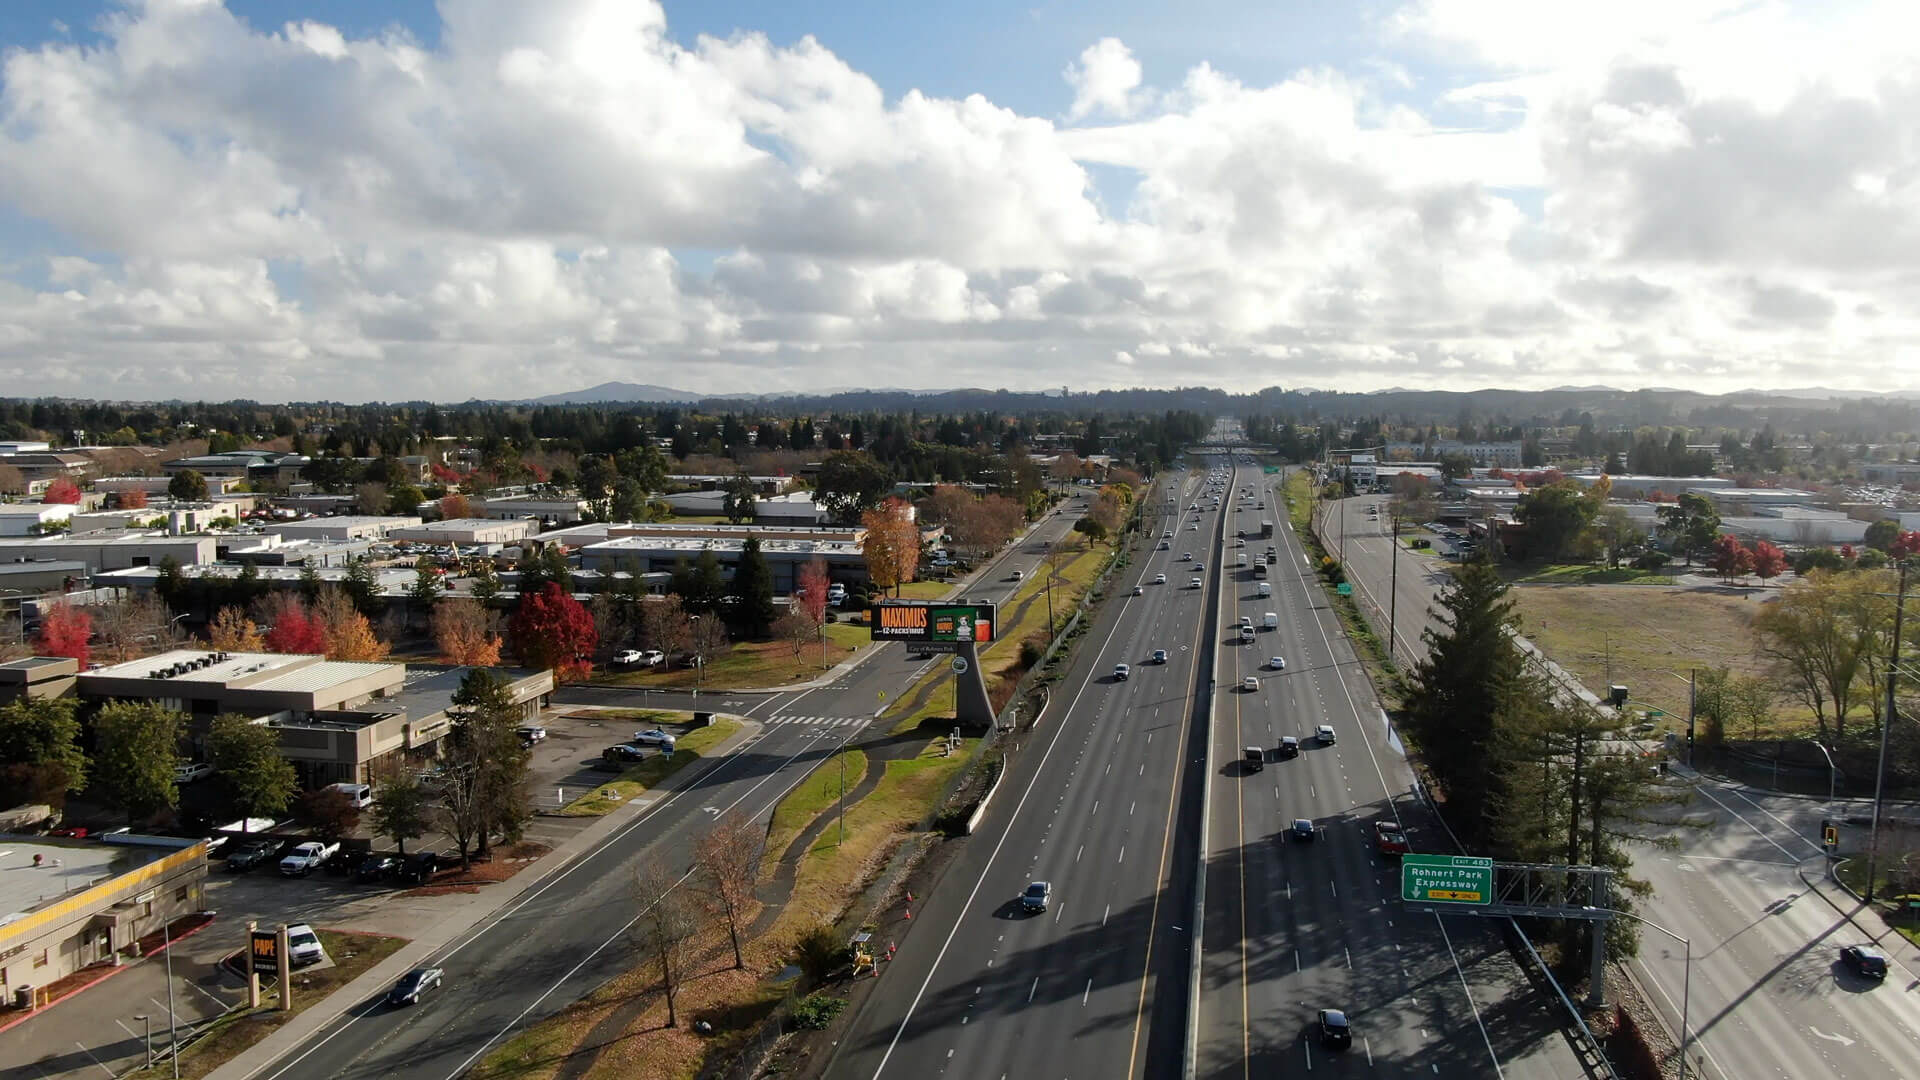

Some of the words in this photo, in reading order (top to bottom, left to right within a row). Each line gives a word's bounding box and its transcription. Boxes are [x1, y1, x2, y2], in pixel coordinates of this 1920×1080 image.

[881, 607, 928, 628] MAXIMUS
[1411, 867, 1454, 878] Rohnert
[1458, 870, 1483, 879] Park
[1415, 878, 1478, 890] Expressway
